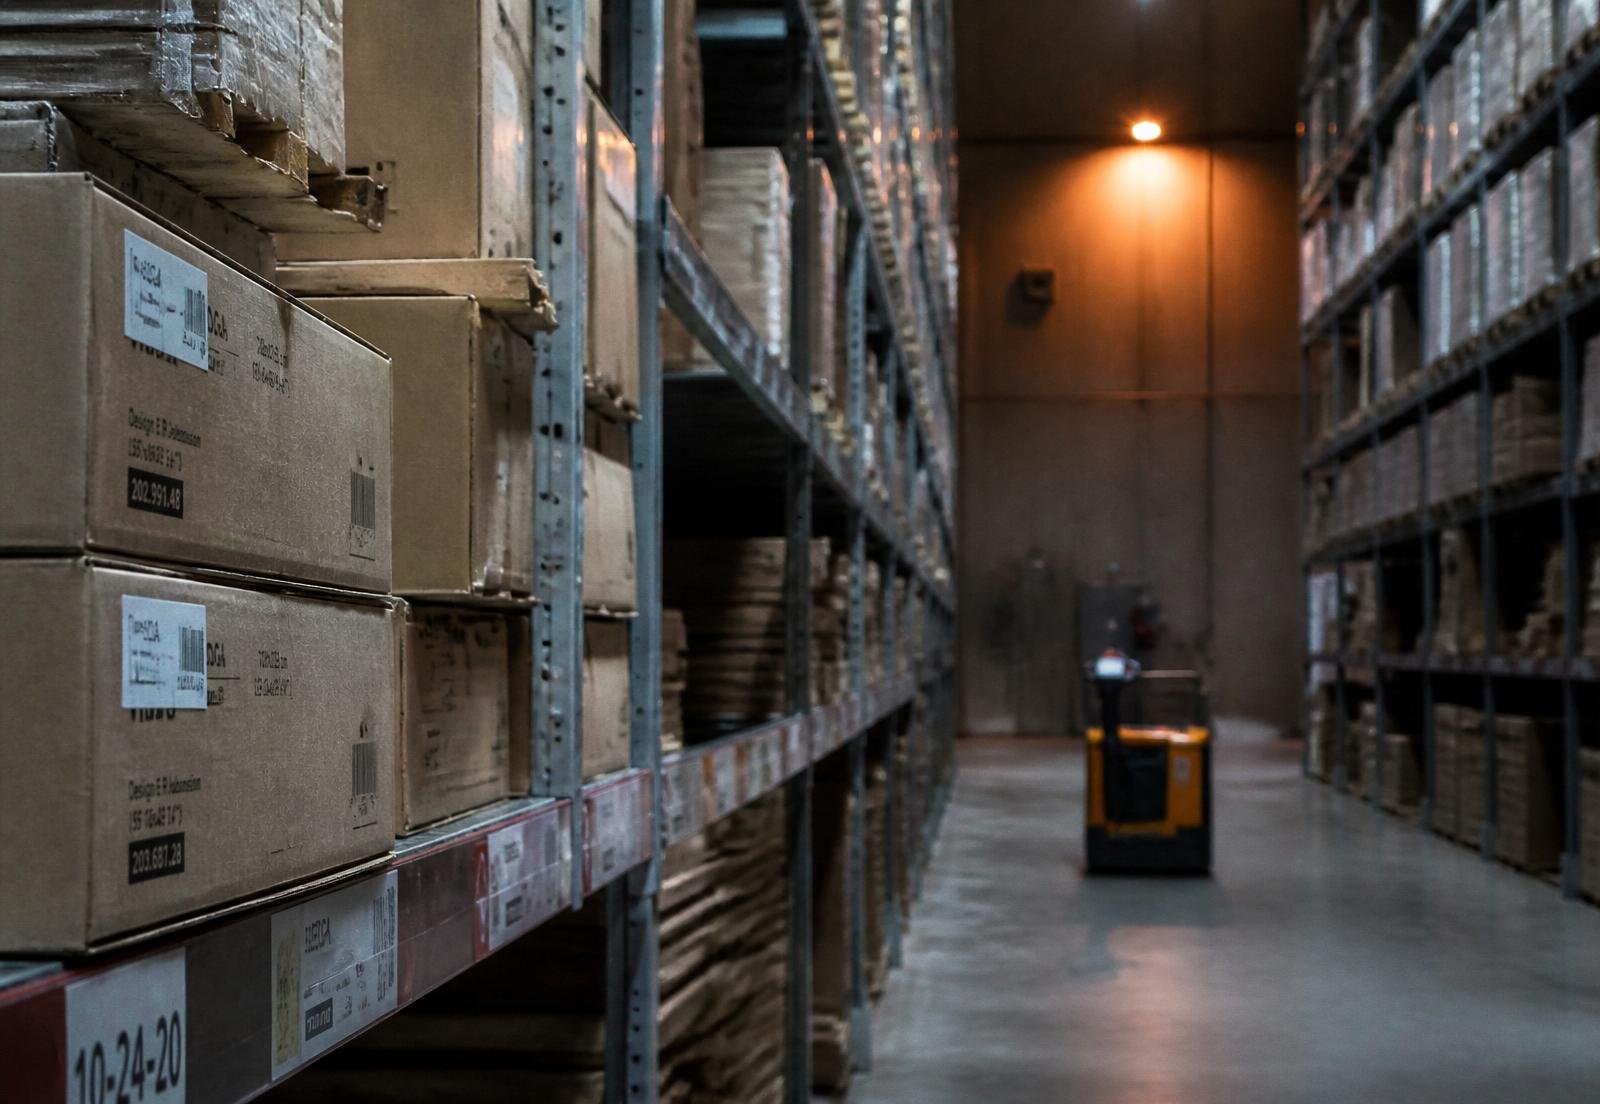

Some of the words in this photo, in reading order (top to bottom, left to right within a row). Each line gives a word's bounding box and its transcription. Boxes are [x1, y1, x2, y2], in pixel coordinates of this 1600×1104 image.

[128, 407, 155, 437] Design
[131, 477, 181, 511] 202.991.48
[128, 780, 155, 803] Design
[131, 842, 182, 875] 203.687.28
[74, 1008, 181, 1104] 10-24-20
